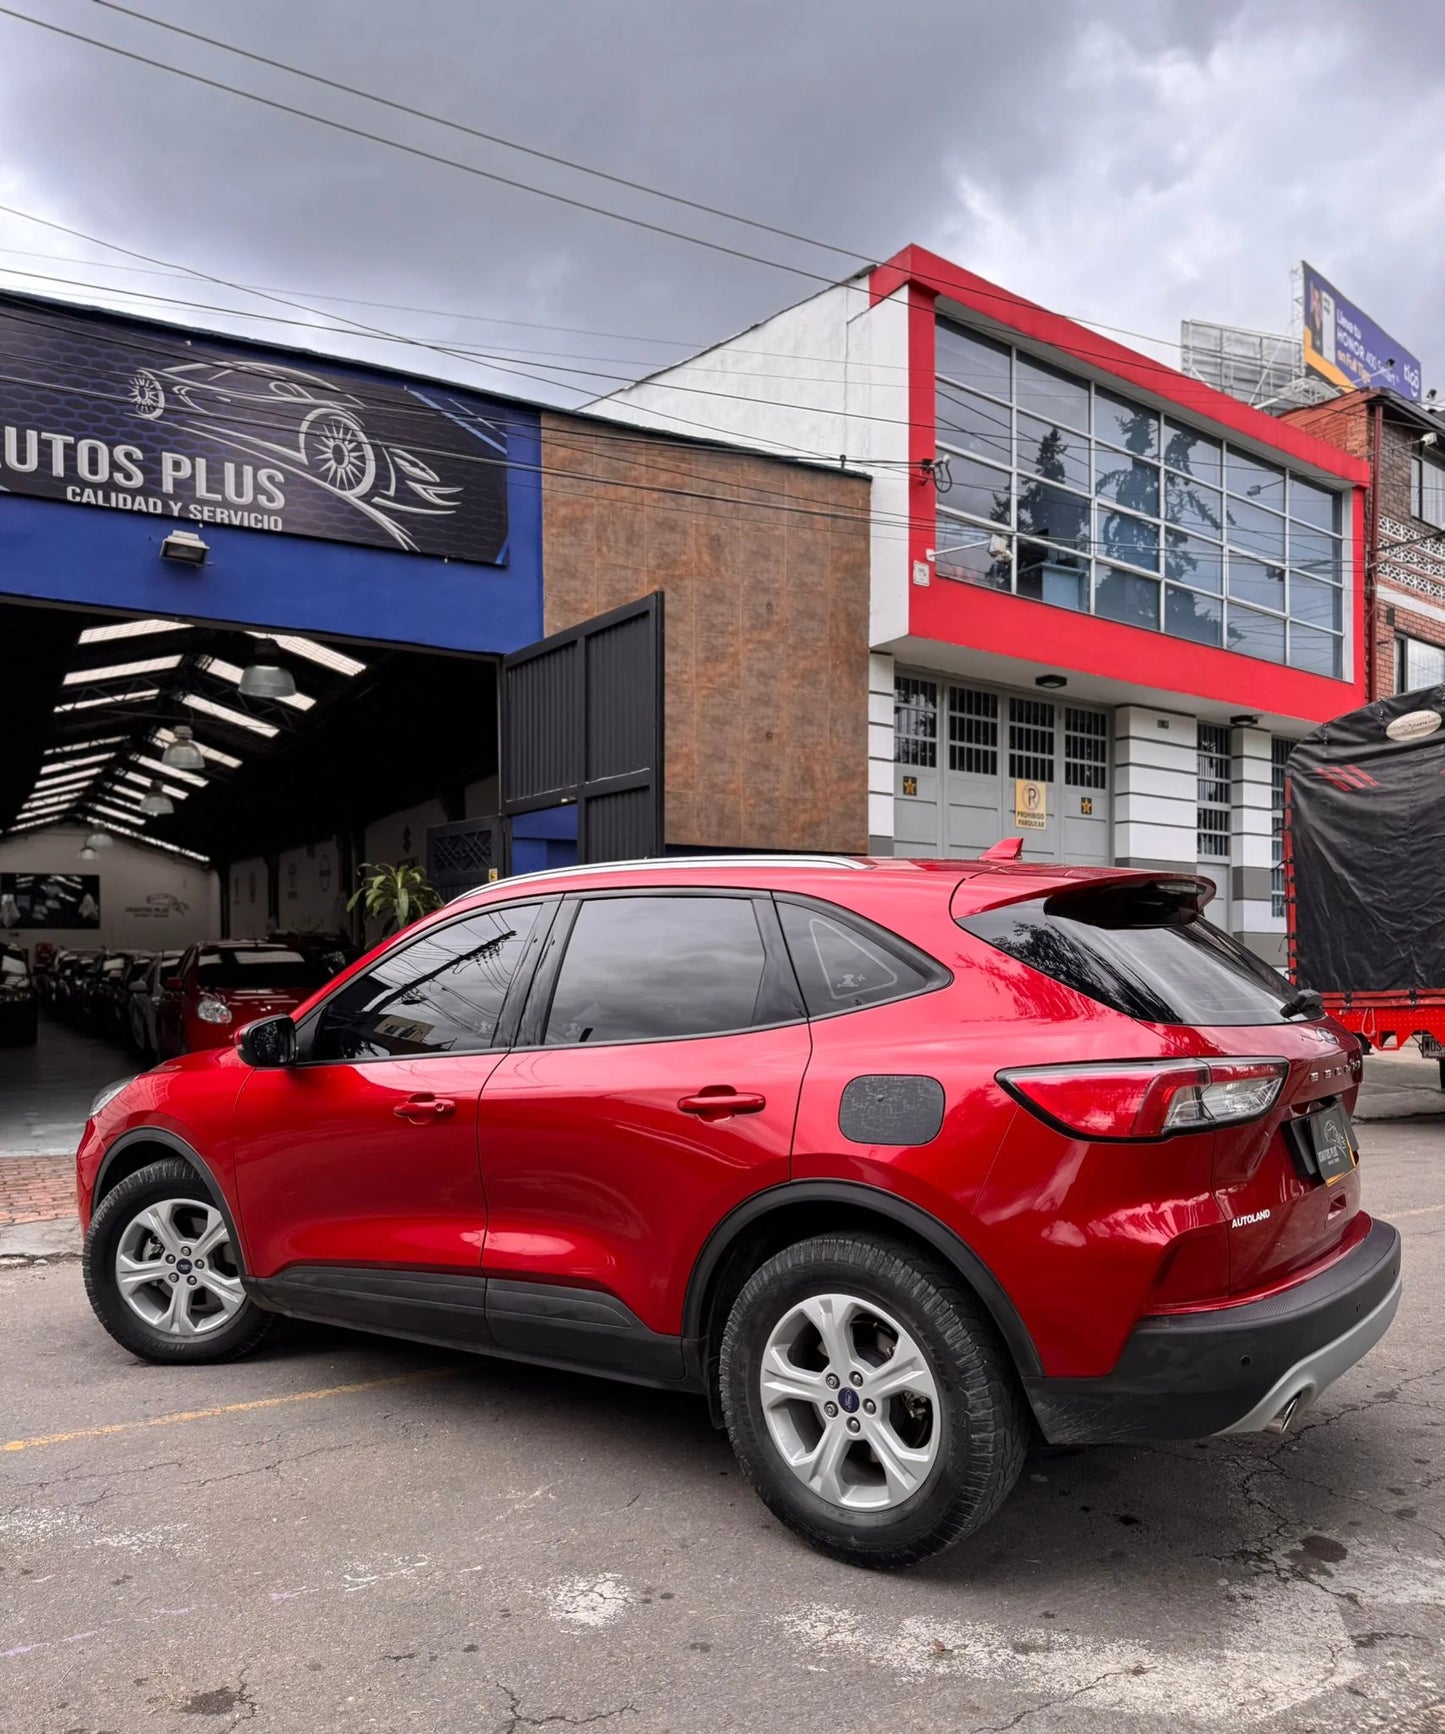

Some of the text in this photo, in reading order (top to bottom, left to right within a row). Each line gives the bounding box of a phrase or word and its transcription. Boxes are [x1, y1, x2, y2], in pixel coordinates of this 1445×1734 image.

[1336, 326, 1365, 361] HONOR
[0, 425, 286, 510] UTOS PLUS
[66, 485, 283, 532] CALIDAD Y SERVICIO
[1017, 811, 1045, 820] PROHIBIDO
[1018, 819, 1045, 828] PARQUEAR
[1231, 1208, 1271, 1229] AUTOLAND
